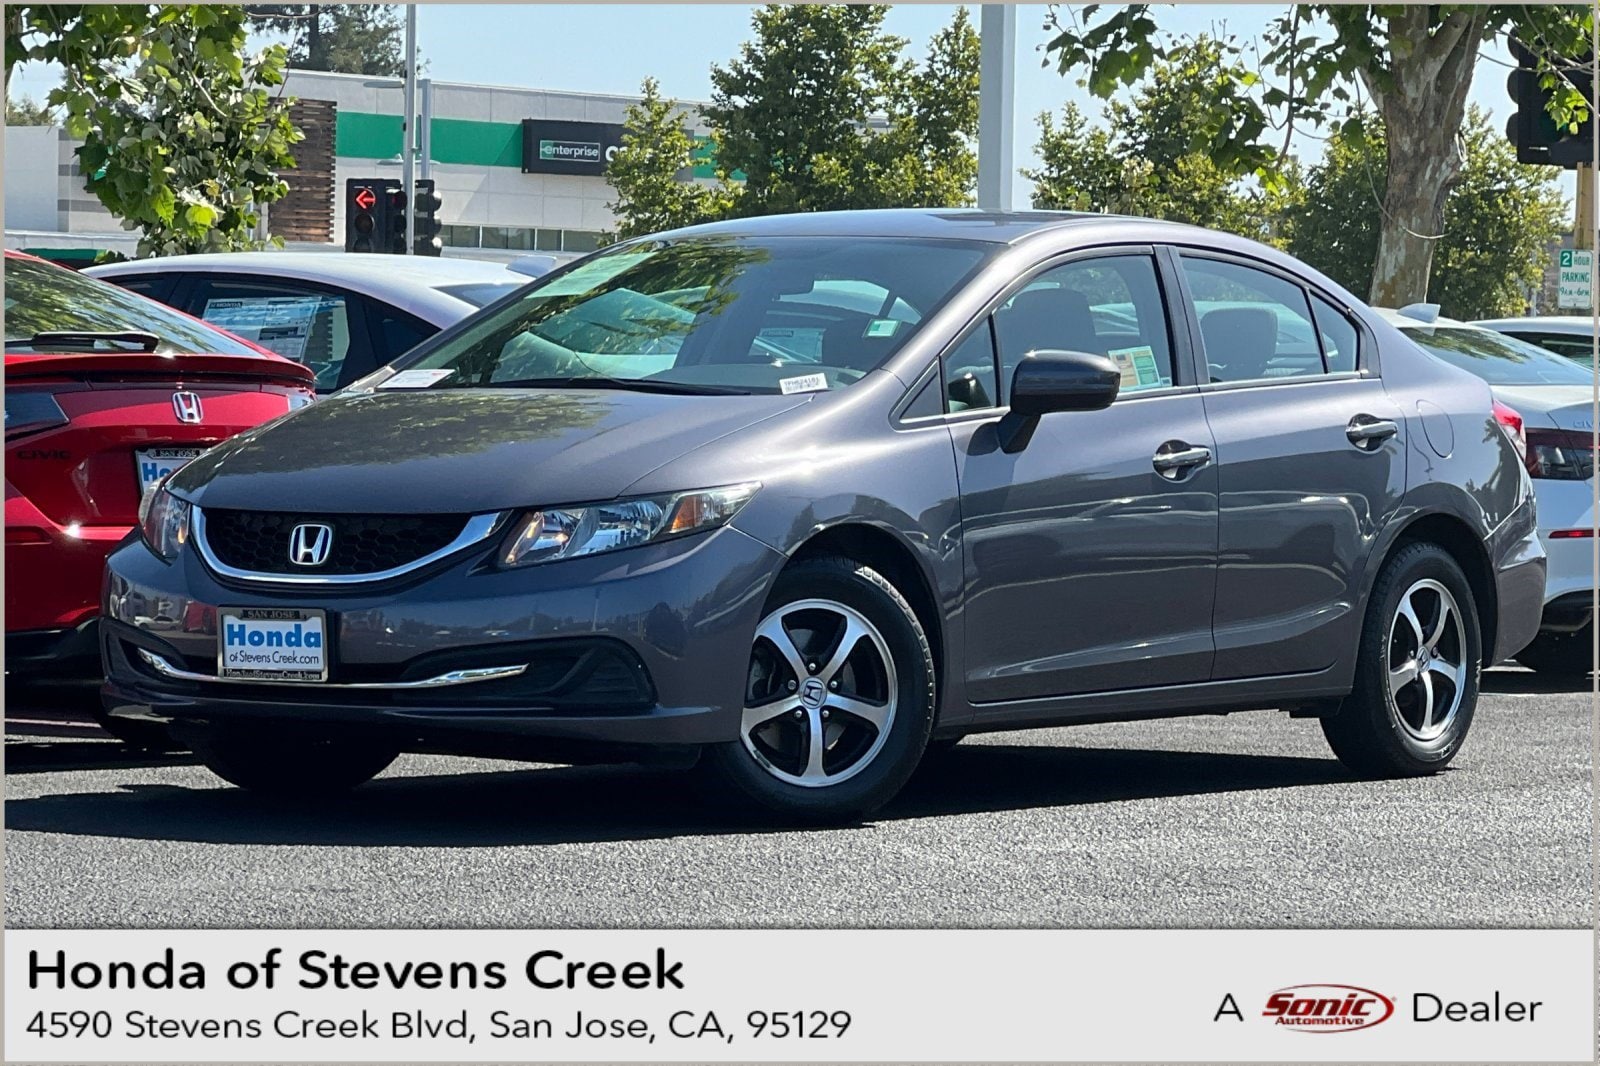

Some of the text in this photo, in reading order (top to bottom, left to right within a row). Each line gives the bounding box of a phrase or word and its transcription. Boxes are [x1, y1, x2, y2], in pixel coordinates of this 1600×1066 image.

[541, 145, 599, 158] enterprise
[1562, 252, 1590, 266] 2 HOUR
[1561, 271, 1590, 283] PARKING
[17, 449, 72, 461] CIVIC
[160, 449, 175, 457] SAN
[247, 610, 296, 619] SAN JOSE
[226, 623, 322, 648] Honda
[229, 650, 320, 665] of Stevens Creek.com
